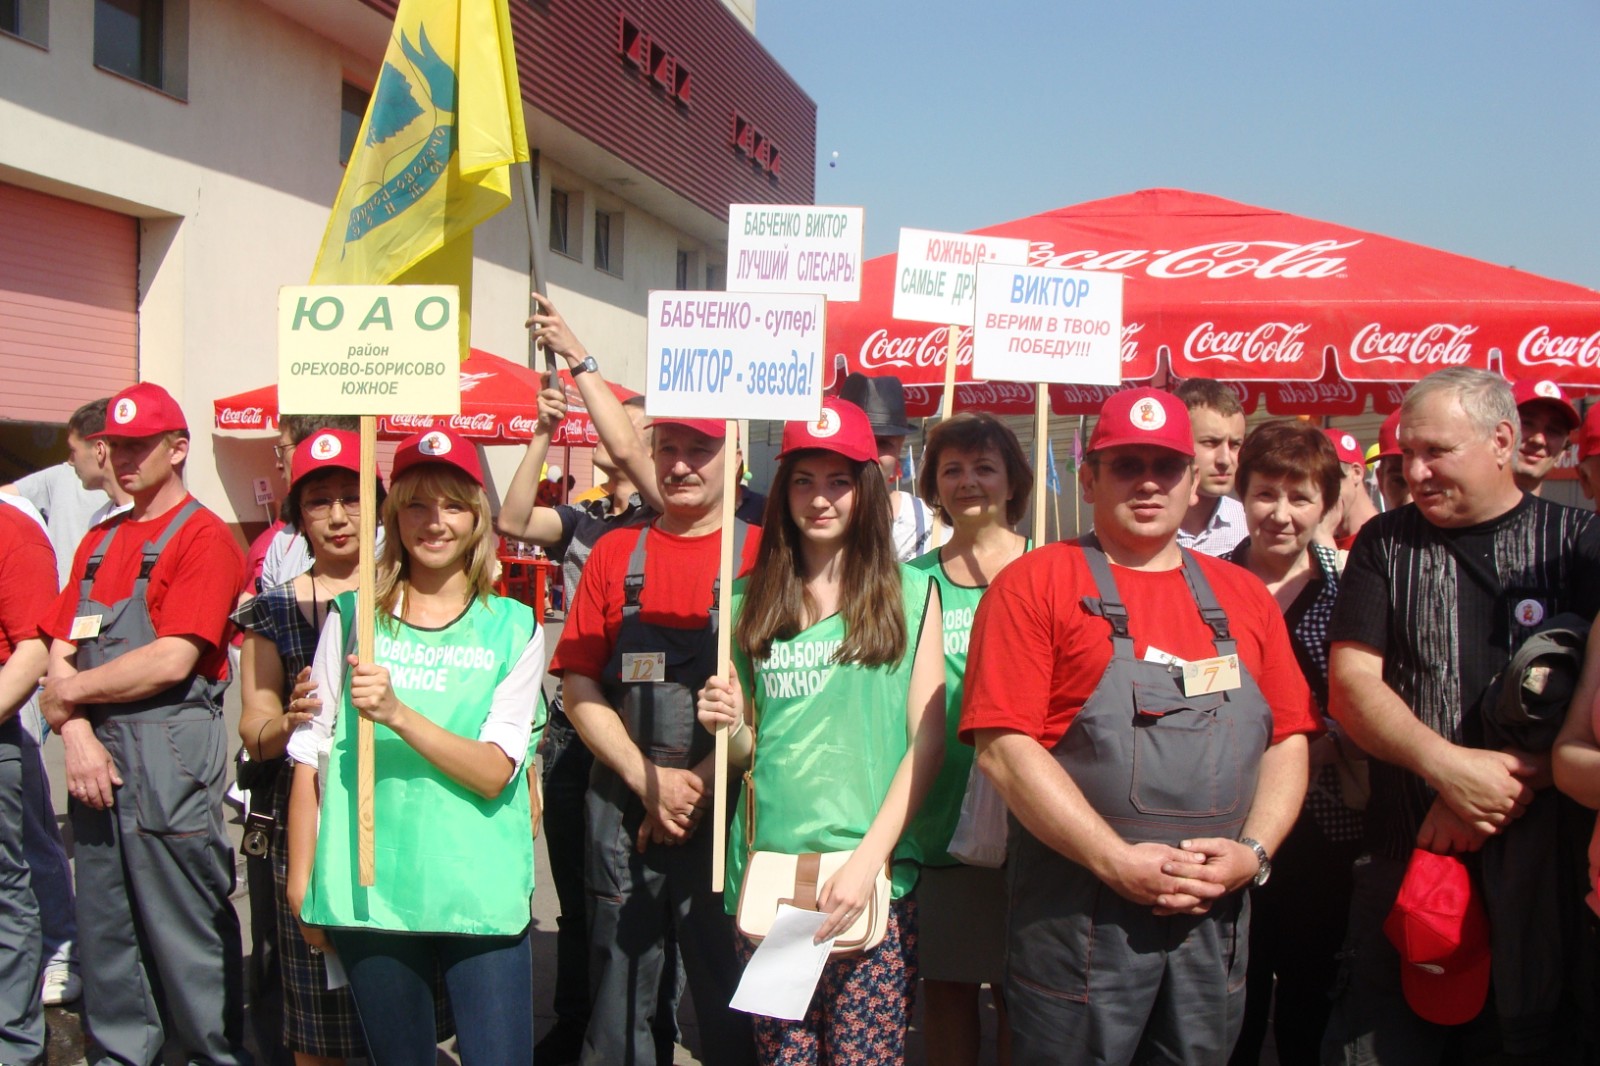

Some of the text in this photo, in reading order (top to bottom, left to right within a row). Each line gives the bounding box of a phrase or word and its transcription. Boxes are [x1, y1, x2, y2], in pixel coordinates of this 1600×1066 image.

[744, 211, 848, 238] БАБЧЕНКО ВИКТОР
[736, 243, 856, 282] ЛУЧШИЙ СЛЕСАРЬ!
[1029, 238, 1364, 279] oca-Cola
[901, 267, 947, 297] САМЫЕ
[1010, 274, 1089, 308] ВИКТОР
[660, 300, 750, 329] БАБЧЕНКО
[765, 304, 816, 337] супер!
[985, 313, 1110, 336] ВЕРИМ В ТВОЮ
[347, 343, 390, 362] район
[1008, 337, 1091, 359] ПОБЕДУ!!!
[1183, 321, 1312, 364] Coca-Cola
[1350, 322, 1479, 365] Coca-Cola
[290, 361, 446, 377] ОРЕХОВО-БОРИСОВО
[658, 347, 733, 393] ВИКТОР
[747, 349, 815, 396] звезда!
[340, 381, 399, 396] ЮЖНОЕ
[221, 407, 264, 424] Coca-Cola
[630, 659, 655, 680] 12
[1203, 666, 1220, 692] 7
